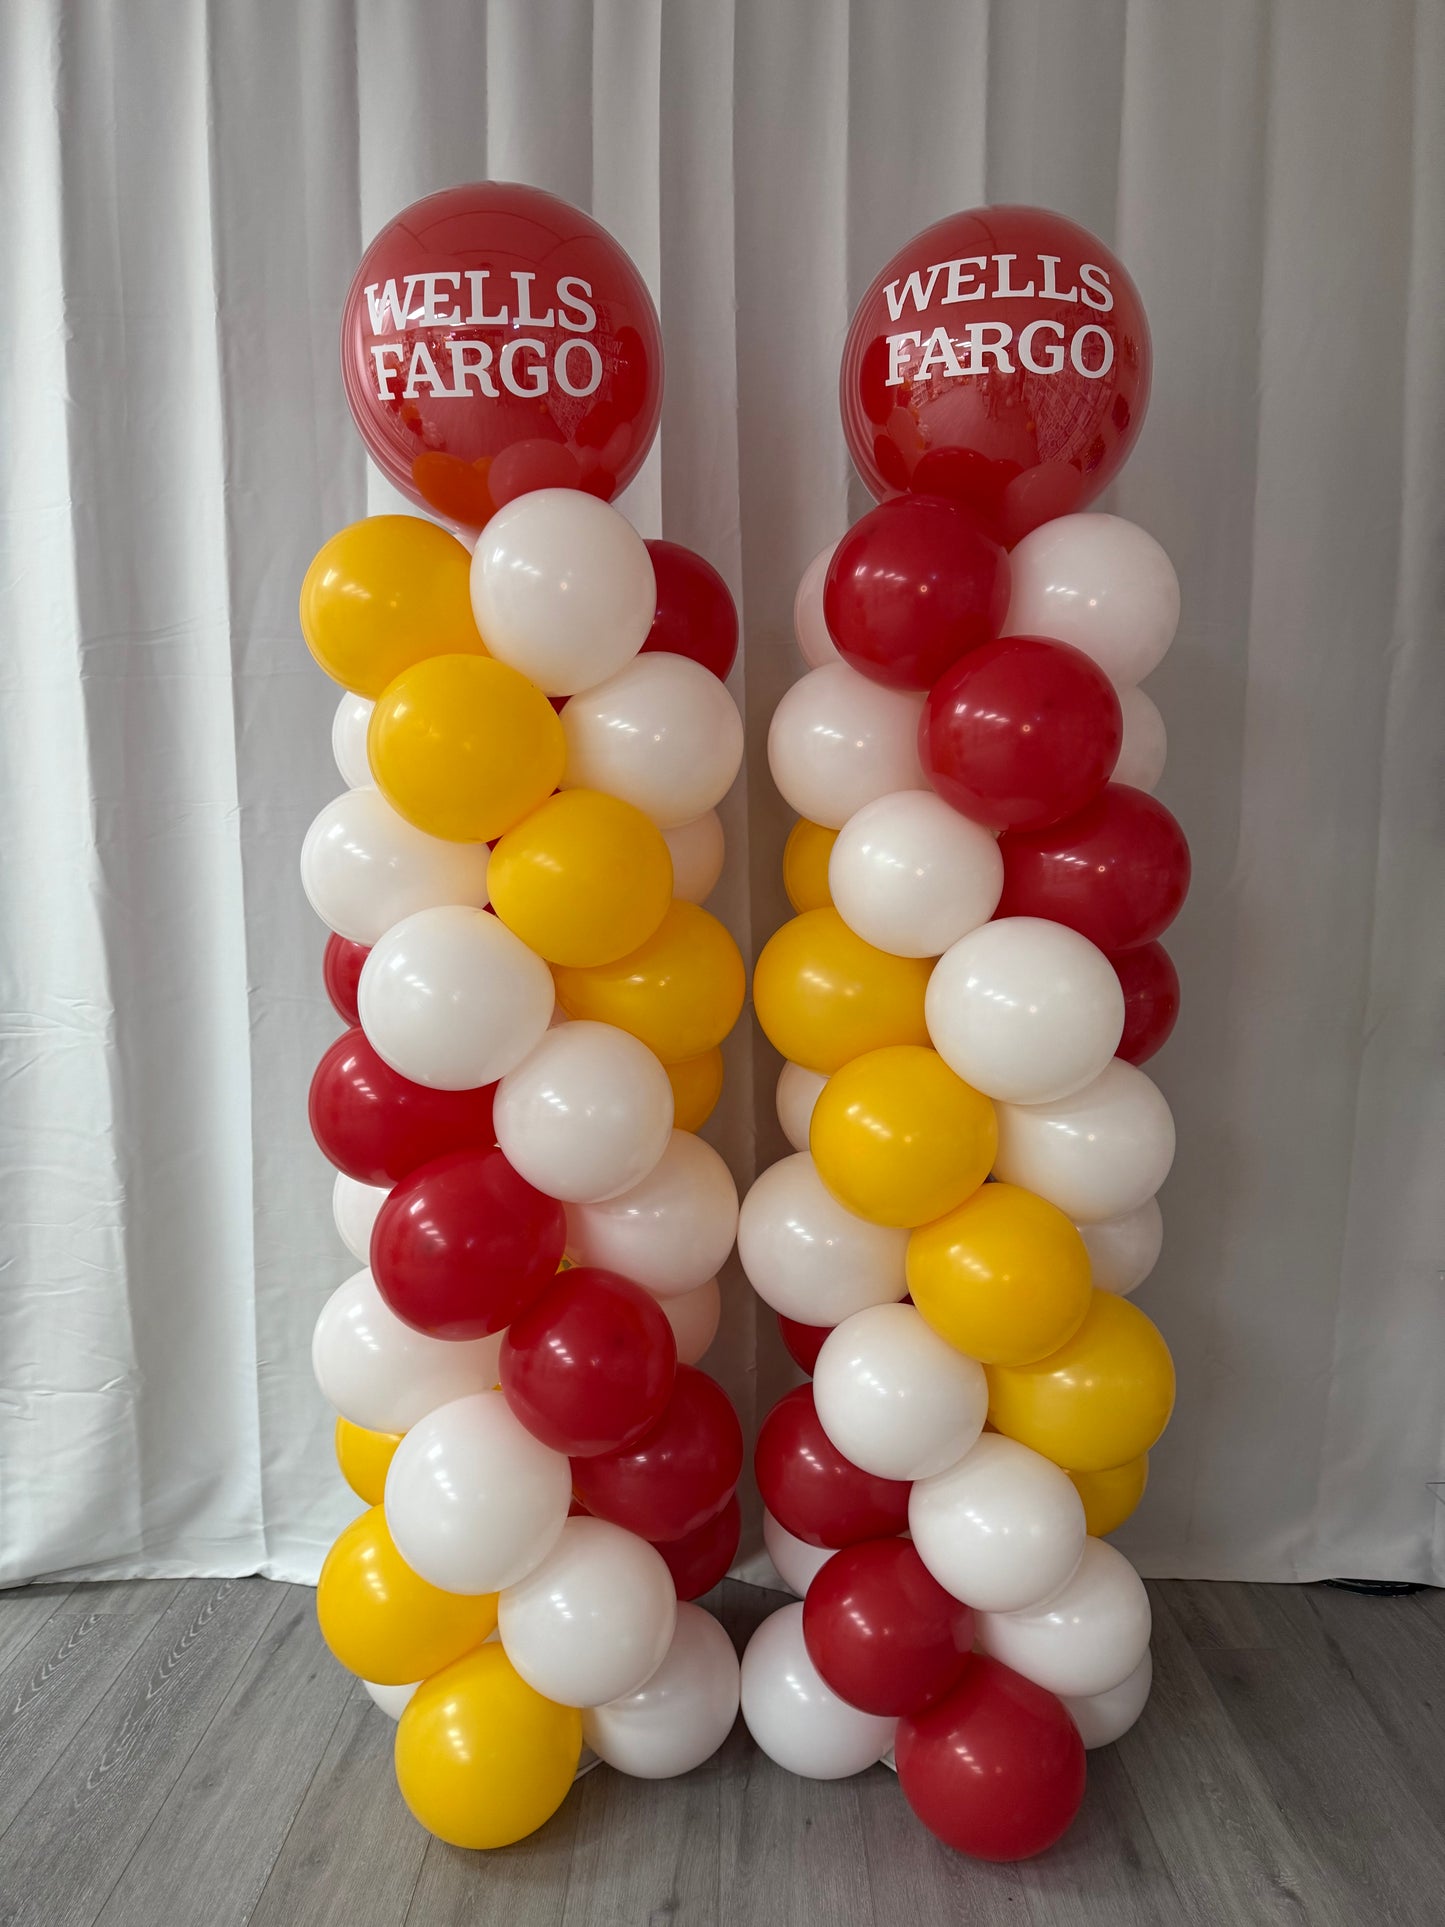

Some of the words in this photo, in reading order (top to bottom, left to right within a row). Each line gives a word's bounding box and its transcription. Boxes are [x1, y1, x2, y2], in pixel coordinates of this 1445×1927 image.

[364, 270, 597, 335] WELLS
[882, 254, 1114, 322] WELLS
[371, 338, 603, 401] FARGO
[885, 319, 1115, 387] FARGO
